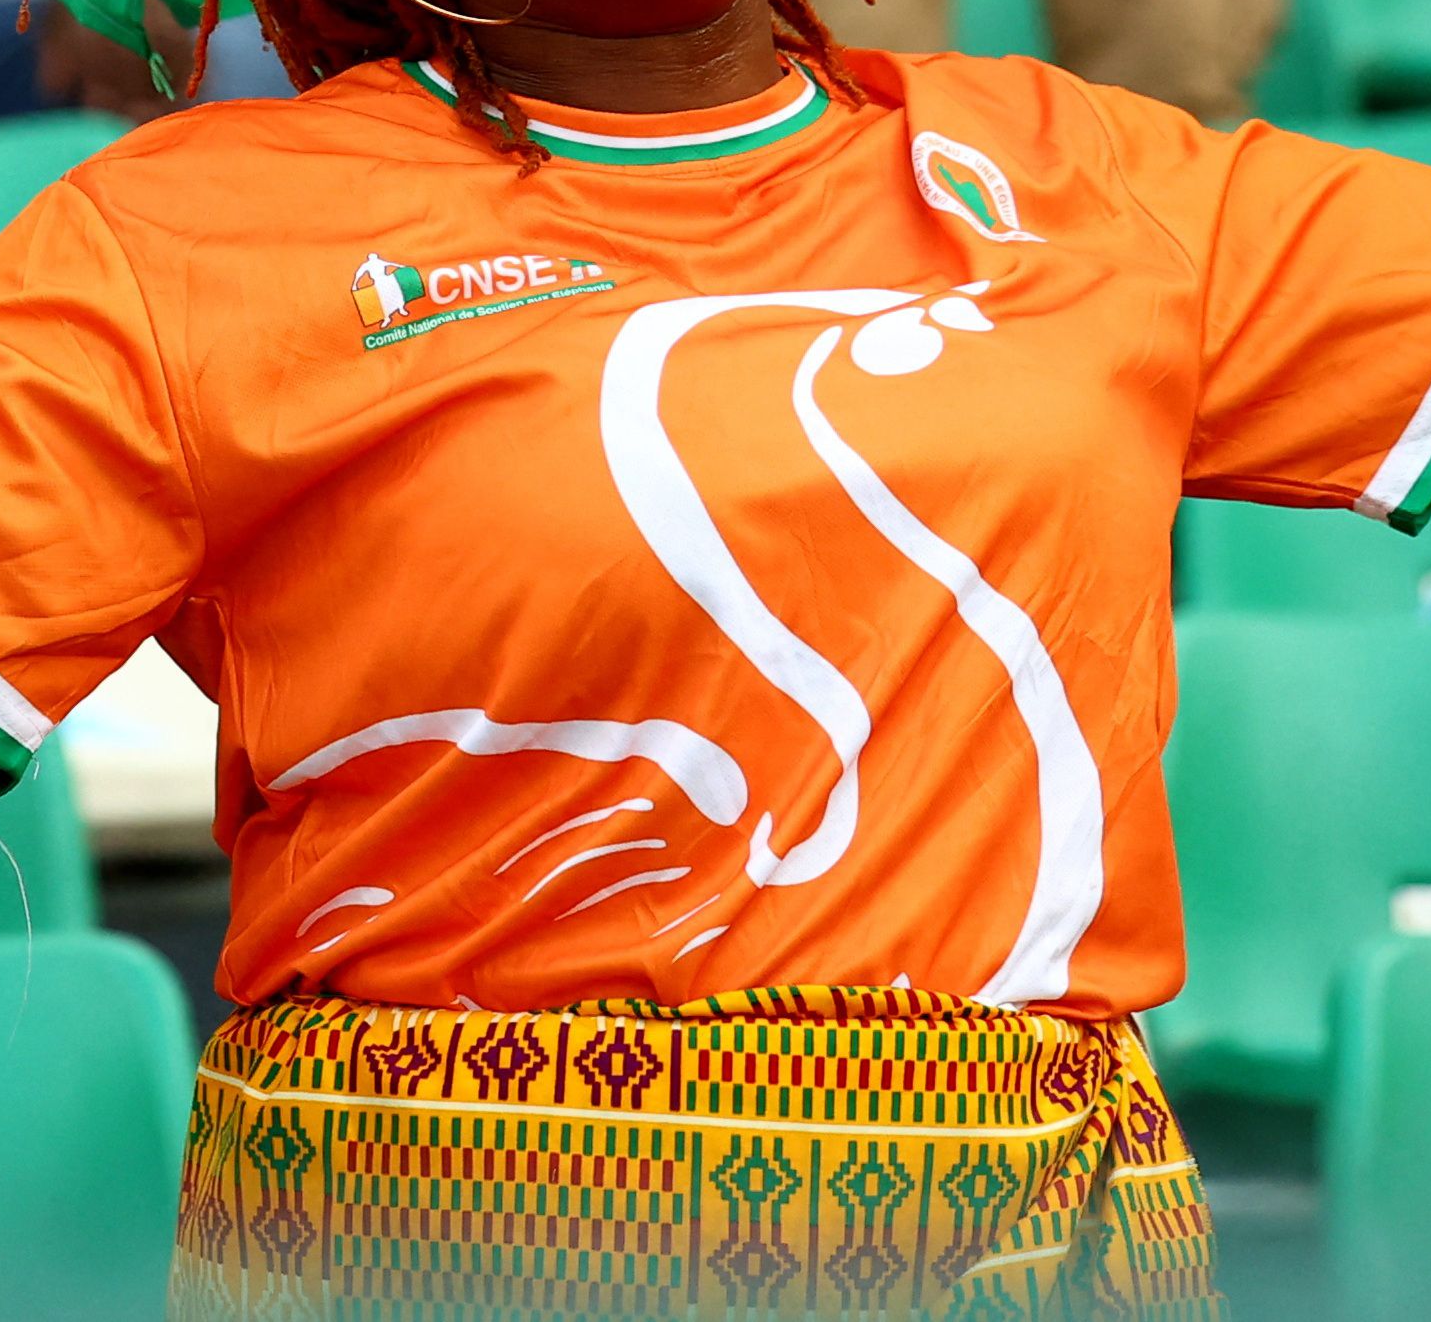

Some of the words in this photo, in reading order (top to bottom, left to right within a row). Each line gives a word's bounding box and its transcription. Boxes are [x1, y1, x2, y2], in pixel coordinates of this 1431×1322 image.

[428, 254, 558, 305] CNSE
[365, 326, 407, 349] Comité
[408, 312, 456, 336] National
[457, 308, 475, 320] de
[476, 299, 525, 317] Soutien
